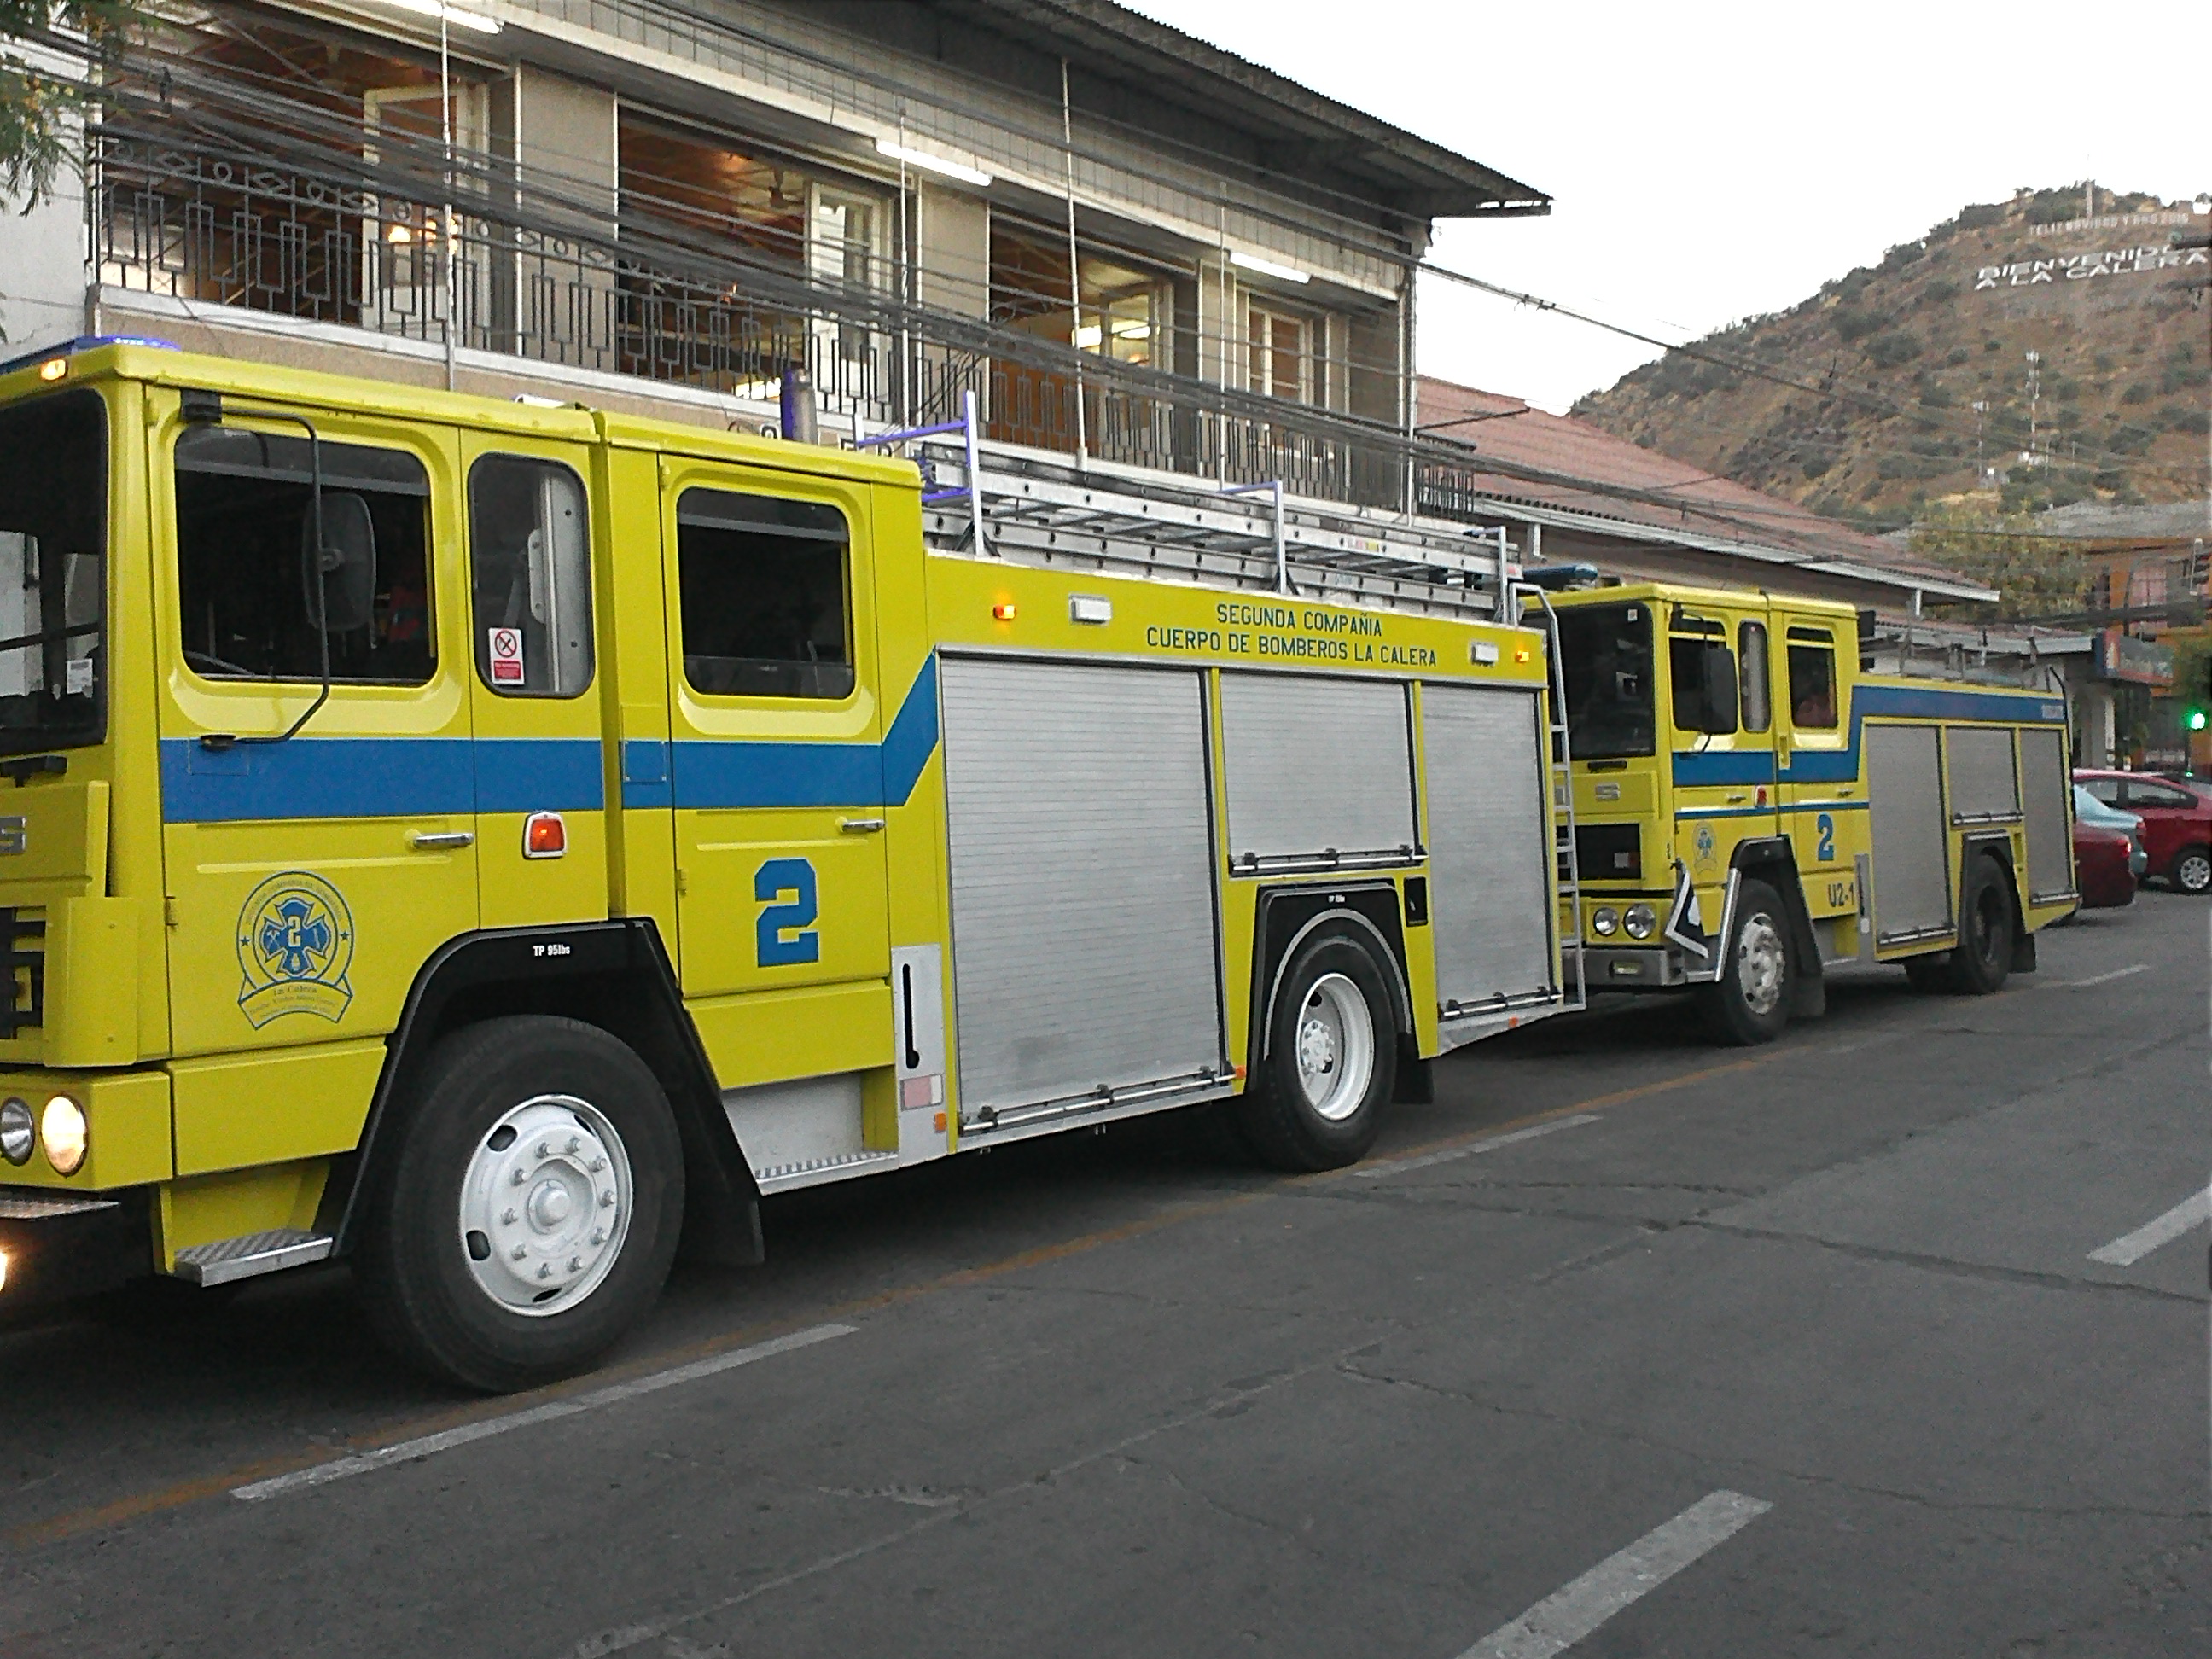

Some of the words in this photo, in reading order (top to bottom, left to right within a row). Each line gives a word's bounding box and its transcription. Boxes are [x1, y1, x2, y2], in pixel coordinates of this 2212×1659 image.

[1978, 244, 2209, 280] BIENVENID
[2011, 271, 2053, 287] LA
[2066, 253, 2209, 280] CALERA
[1216, 603, 1295, 630] SEGUNDA
[1303, 612, 1382, 637] COMPAÑIA
[1146, 626, 1221, 652] CUERPO
[1228, 632, 1250, 653] DE
[1258, 635, 1348, 661] BOMBEROS
[1353, 642, 1374, 663] LA
[1379, 645, 1437, 667] CALERA
[1817, 812, 1836, 862] 2
[754, 857, 820, 969] 2
[288, 915, 301, 947] 2
[533, 945, 545, 957] TP
[547, 944, 571, 956] 95lbs
